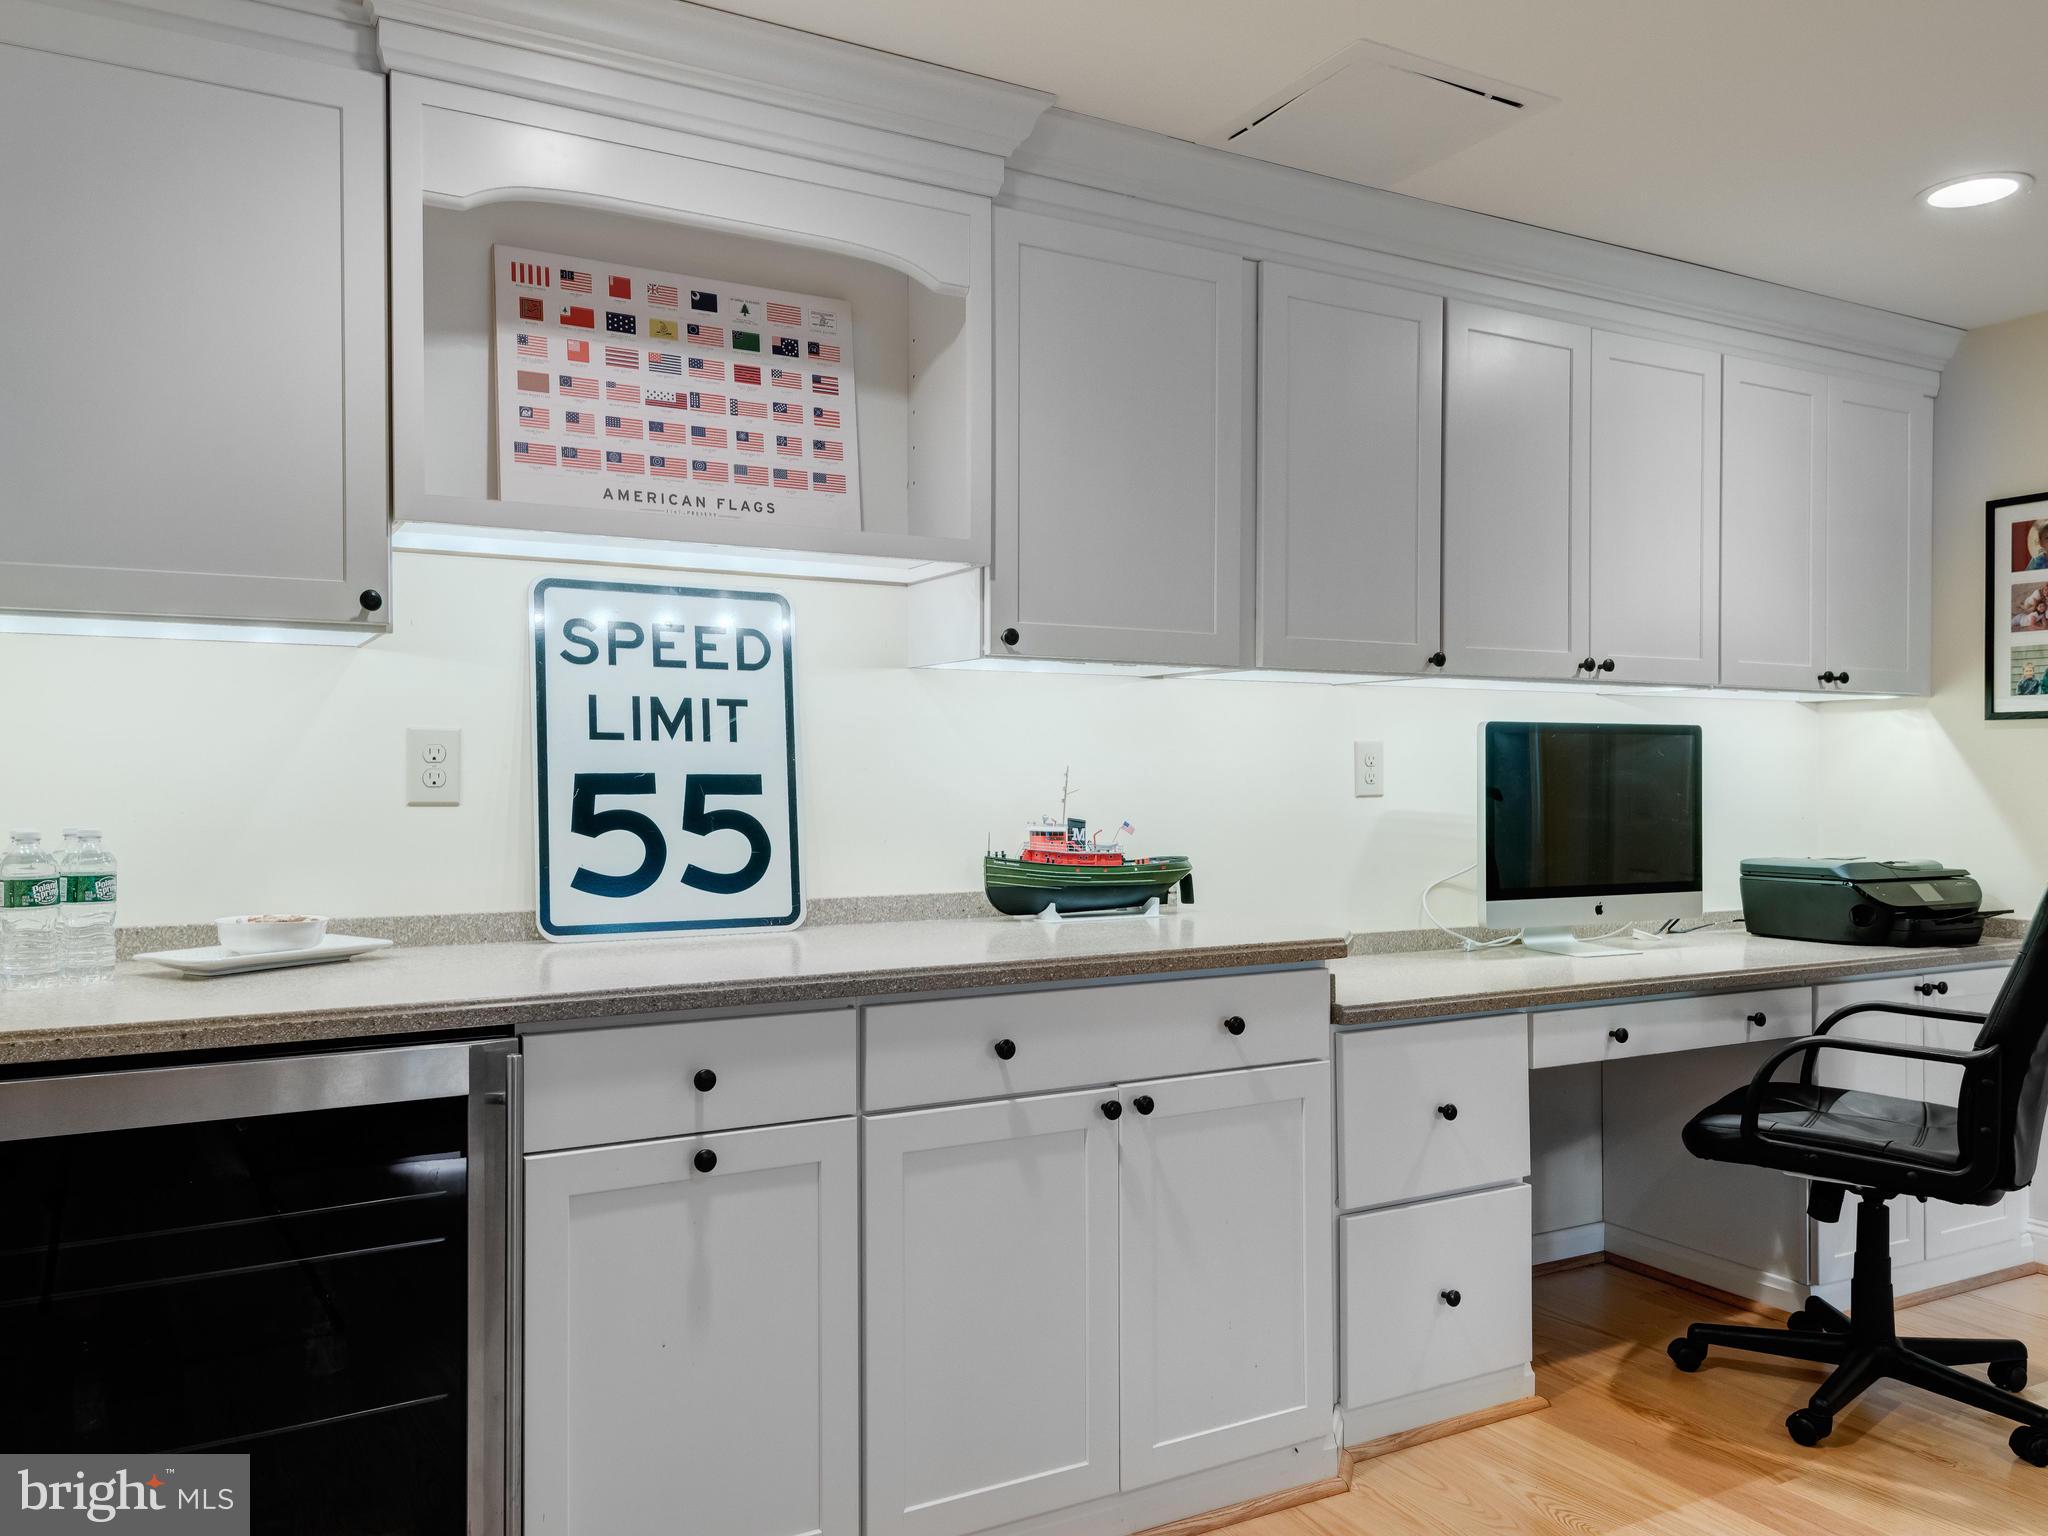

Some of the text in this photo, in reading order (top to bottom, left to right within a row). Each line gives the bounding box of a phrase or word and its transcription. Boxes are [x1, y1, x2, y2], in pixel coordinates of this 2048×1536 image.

[603, 488, 706, 509] AMERICAN
[717, 498, 776, 514] FLAGS
[560, 617, 772, 672] SPEED
[588, 694, 749, 743] LIMIT
[570, 772, 772, 898] 55
[1072, 827, 1086, 841] M
